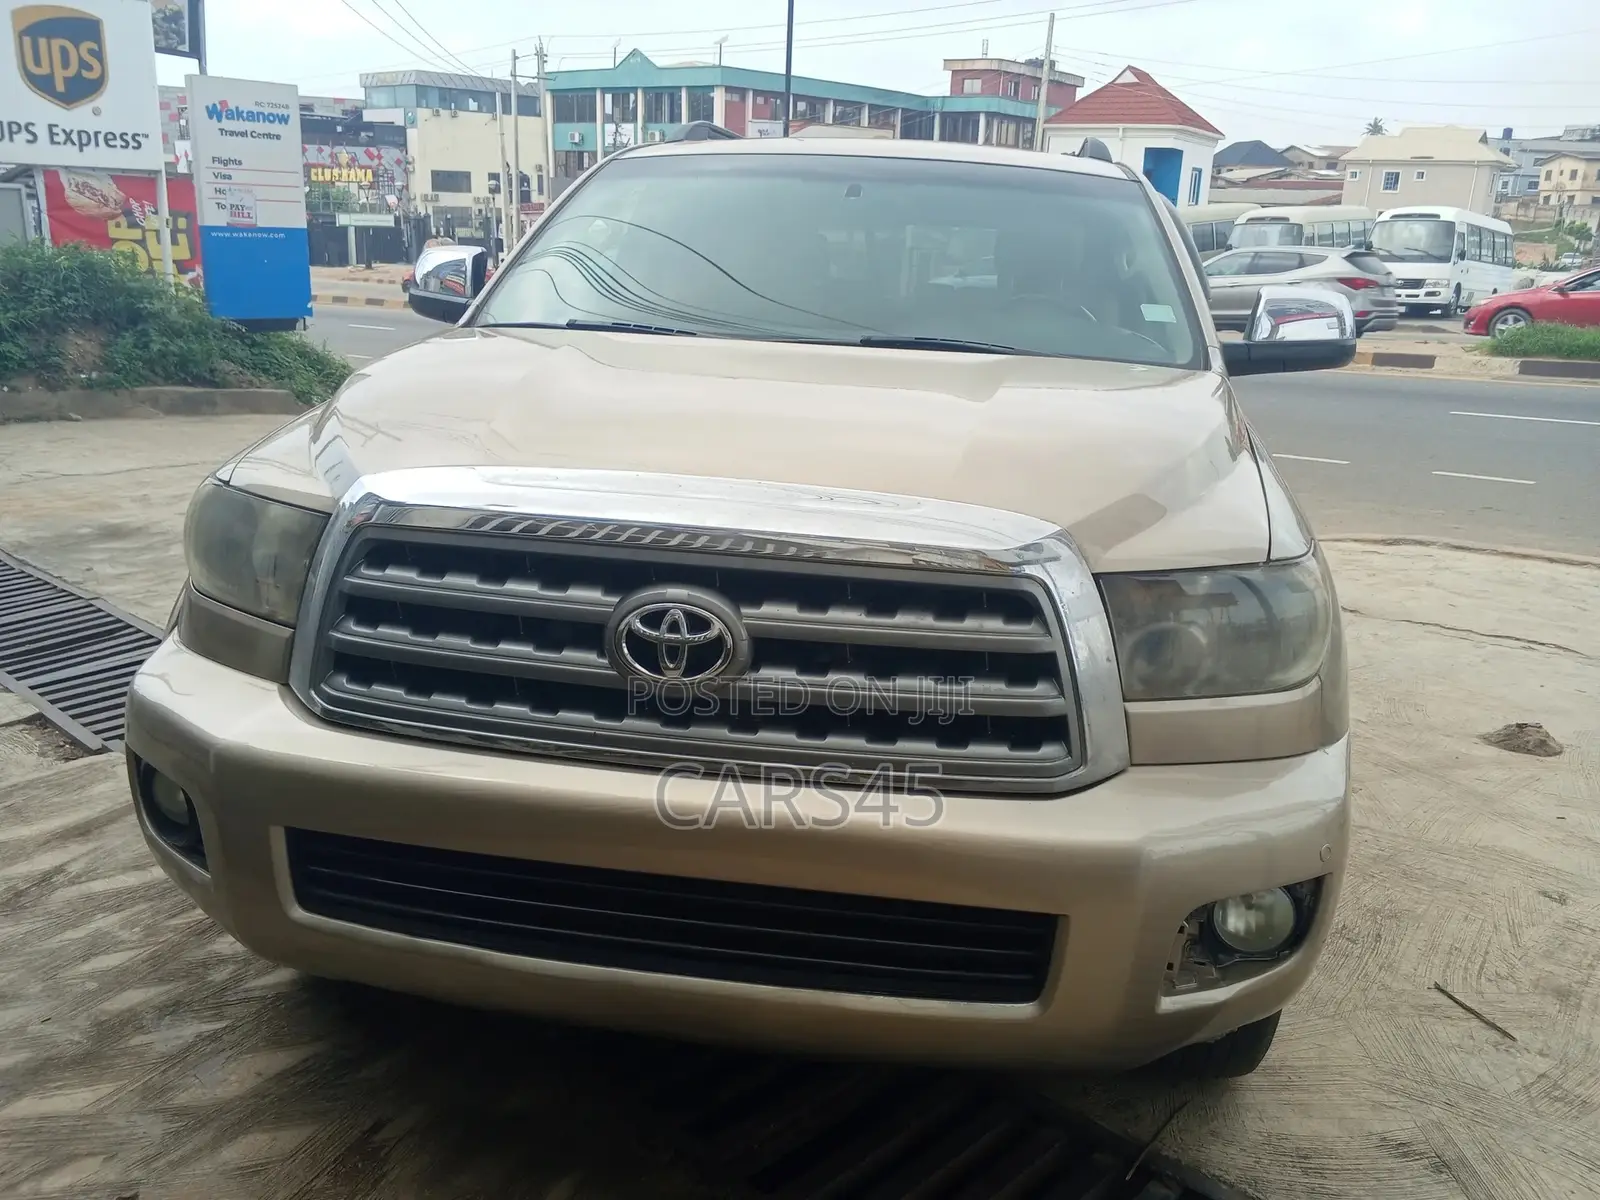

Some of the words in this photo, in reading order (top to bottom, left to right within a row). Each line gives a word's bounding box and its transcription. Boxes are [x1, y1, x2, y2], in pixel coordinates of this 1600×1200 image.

[22, 36, 102, 92] ups
[205, 103, 290, 125] Wakanow
[218, 128, 248, 138] Travel
[250, 130, 282, 141] Centre
[212, 156, 243, 167] Flights
[212, 172, 233, 181] Visa
[211, 231, 286, 239] www.wakanow.com
